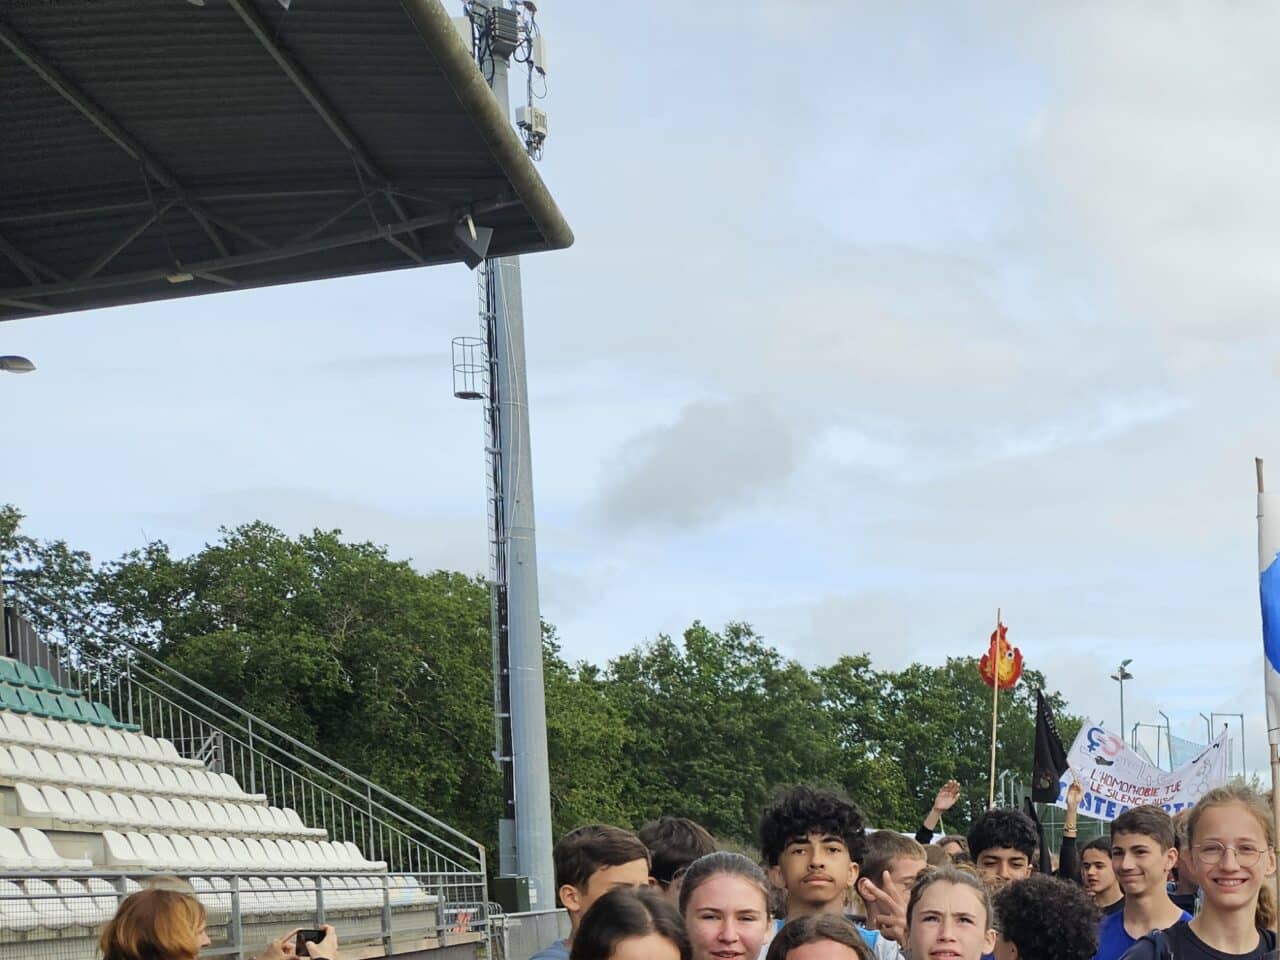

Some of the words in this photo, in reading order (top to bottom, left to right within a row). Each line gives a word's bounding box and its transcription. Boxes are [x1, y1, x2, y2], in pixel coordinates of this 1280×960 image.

[1090, 768, 1160, 797] L'HOMOPHOBIE
[1166, 779, 1182, 795] TUE
[1090, 781, 1101, 794] LE
